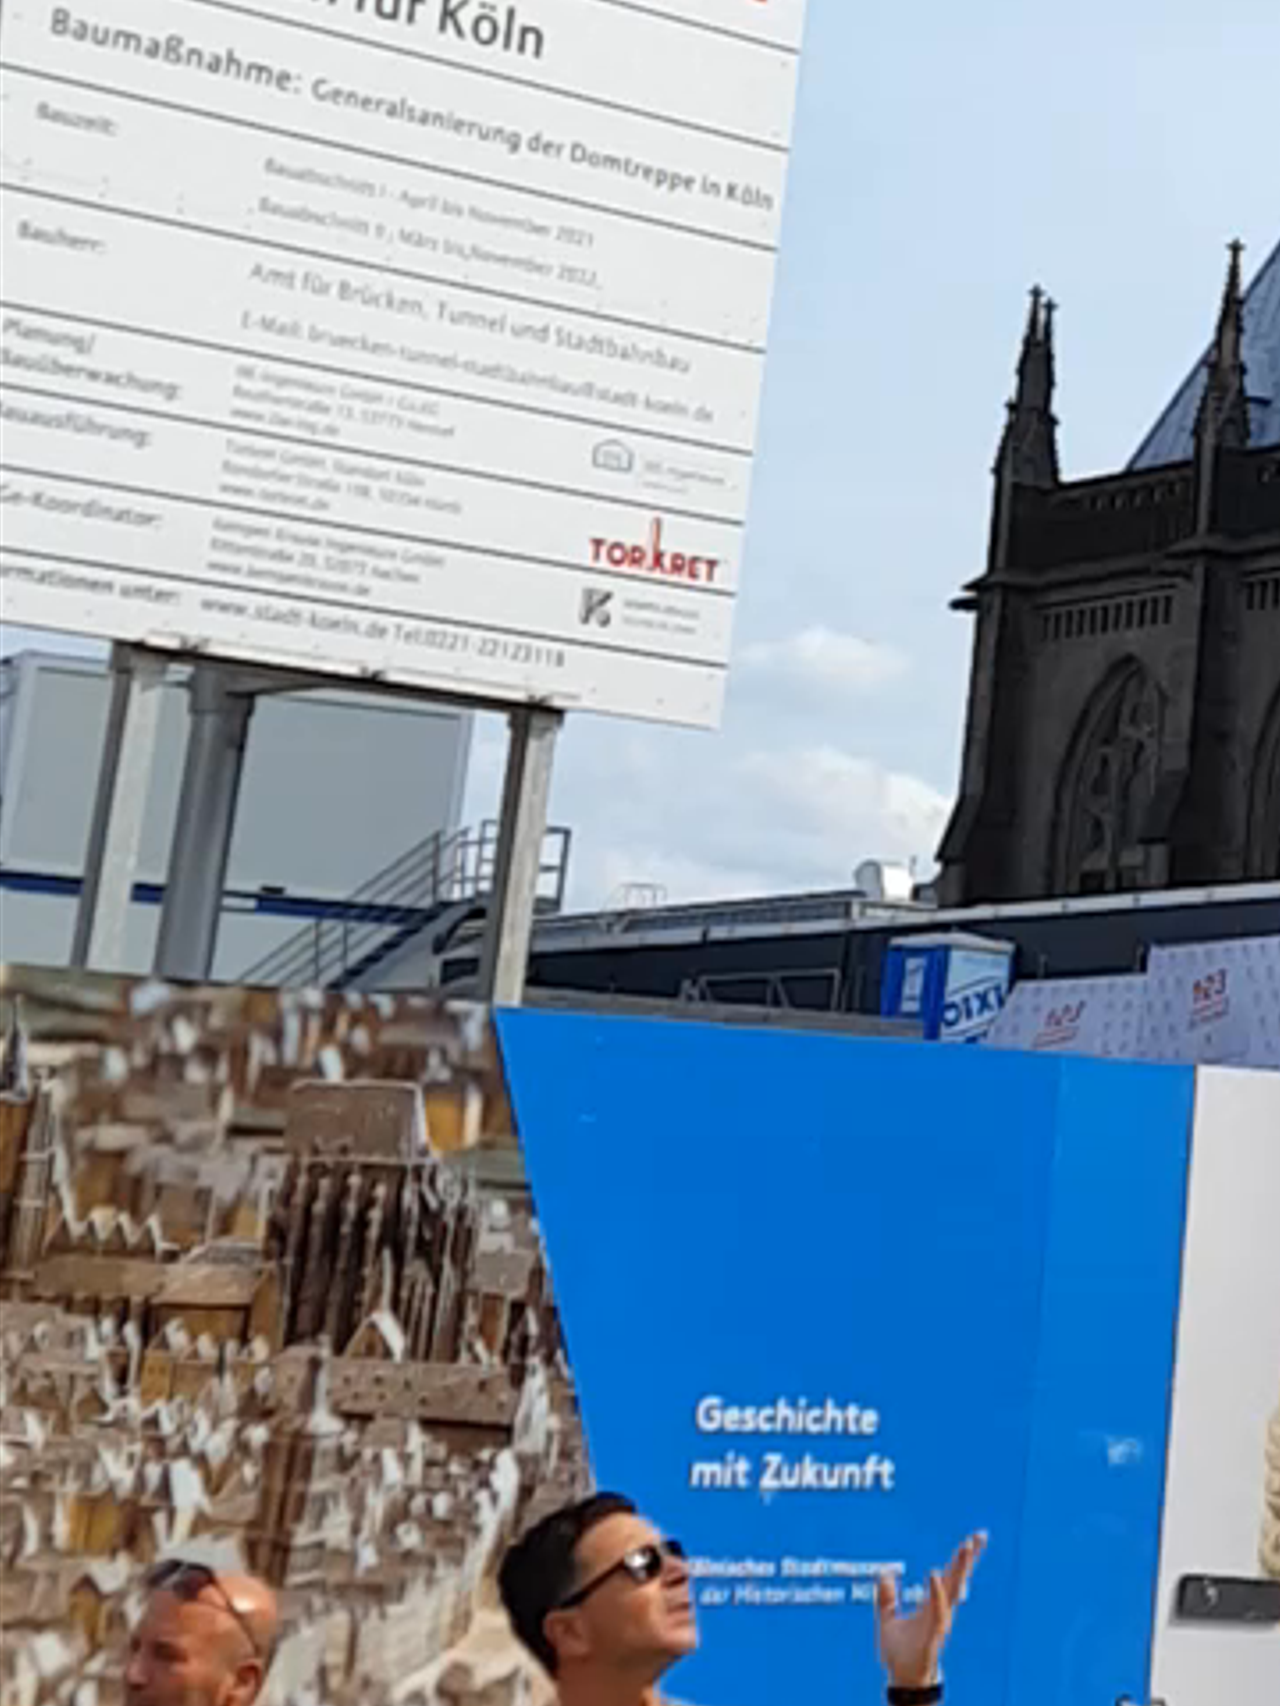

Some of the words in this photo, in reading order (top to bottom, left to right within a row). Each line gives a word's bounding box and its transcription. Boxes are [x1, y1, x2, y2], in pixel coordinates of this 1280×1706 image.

[48, 4, 304, 95] Baumaßnahme:
[309, 75, 523, 155] Generalsanierung
[525, 129, 567, 160] der
[569, 142, 697, 197] Domtreppe
[699, 173, 722, 198] in
[724, 178, 776, 212] Köln
[249, 260, 295, 290] Amt
[300, 271, 330, 298] für
[436, 301, 506, 335] Tunnel
[509, 316, 550, 345] und
[553, 326, 692, 375] Stadtbahnbau
[589, 516, 719, 583] TORKRET
[695, 1394, 880, 1435] Geschichte
[690, 1449, 752, 1489] mit
[759, 1450, 896, 1491] Zukunft
